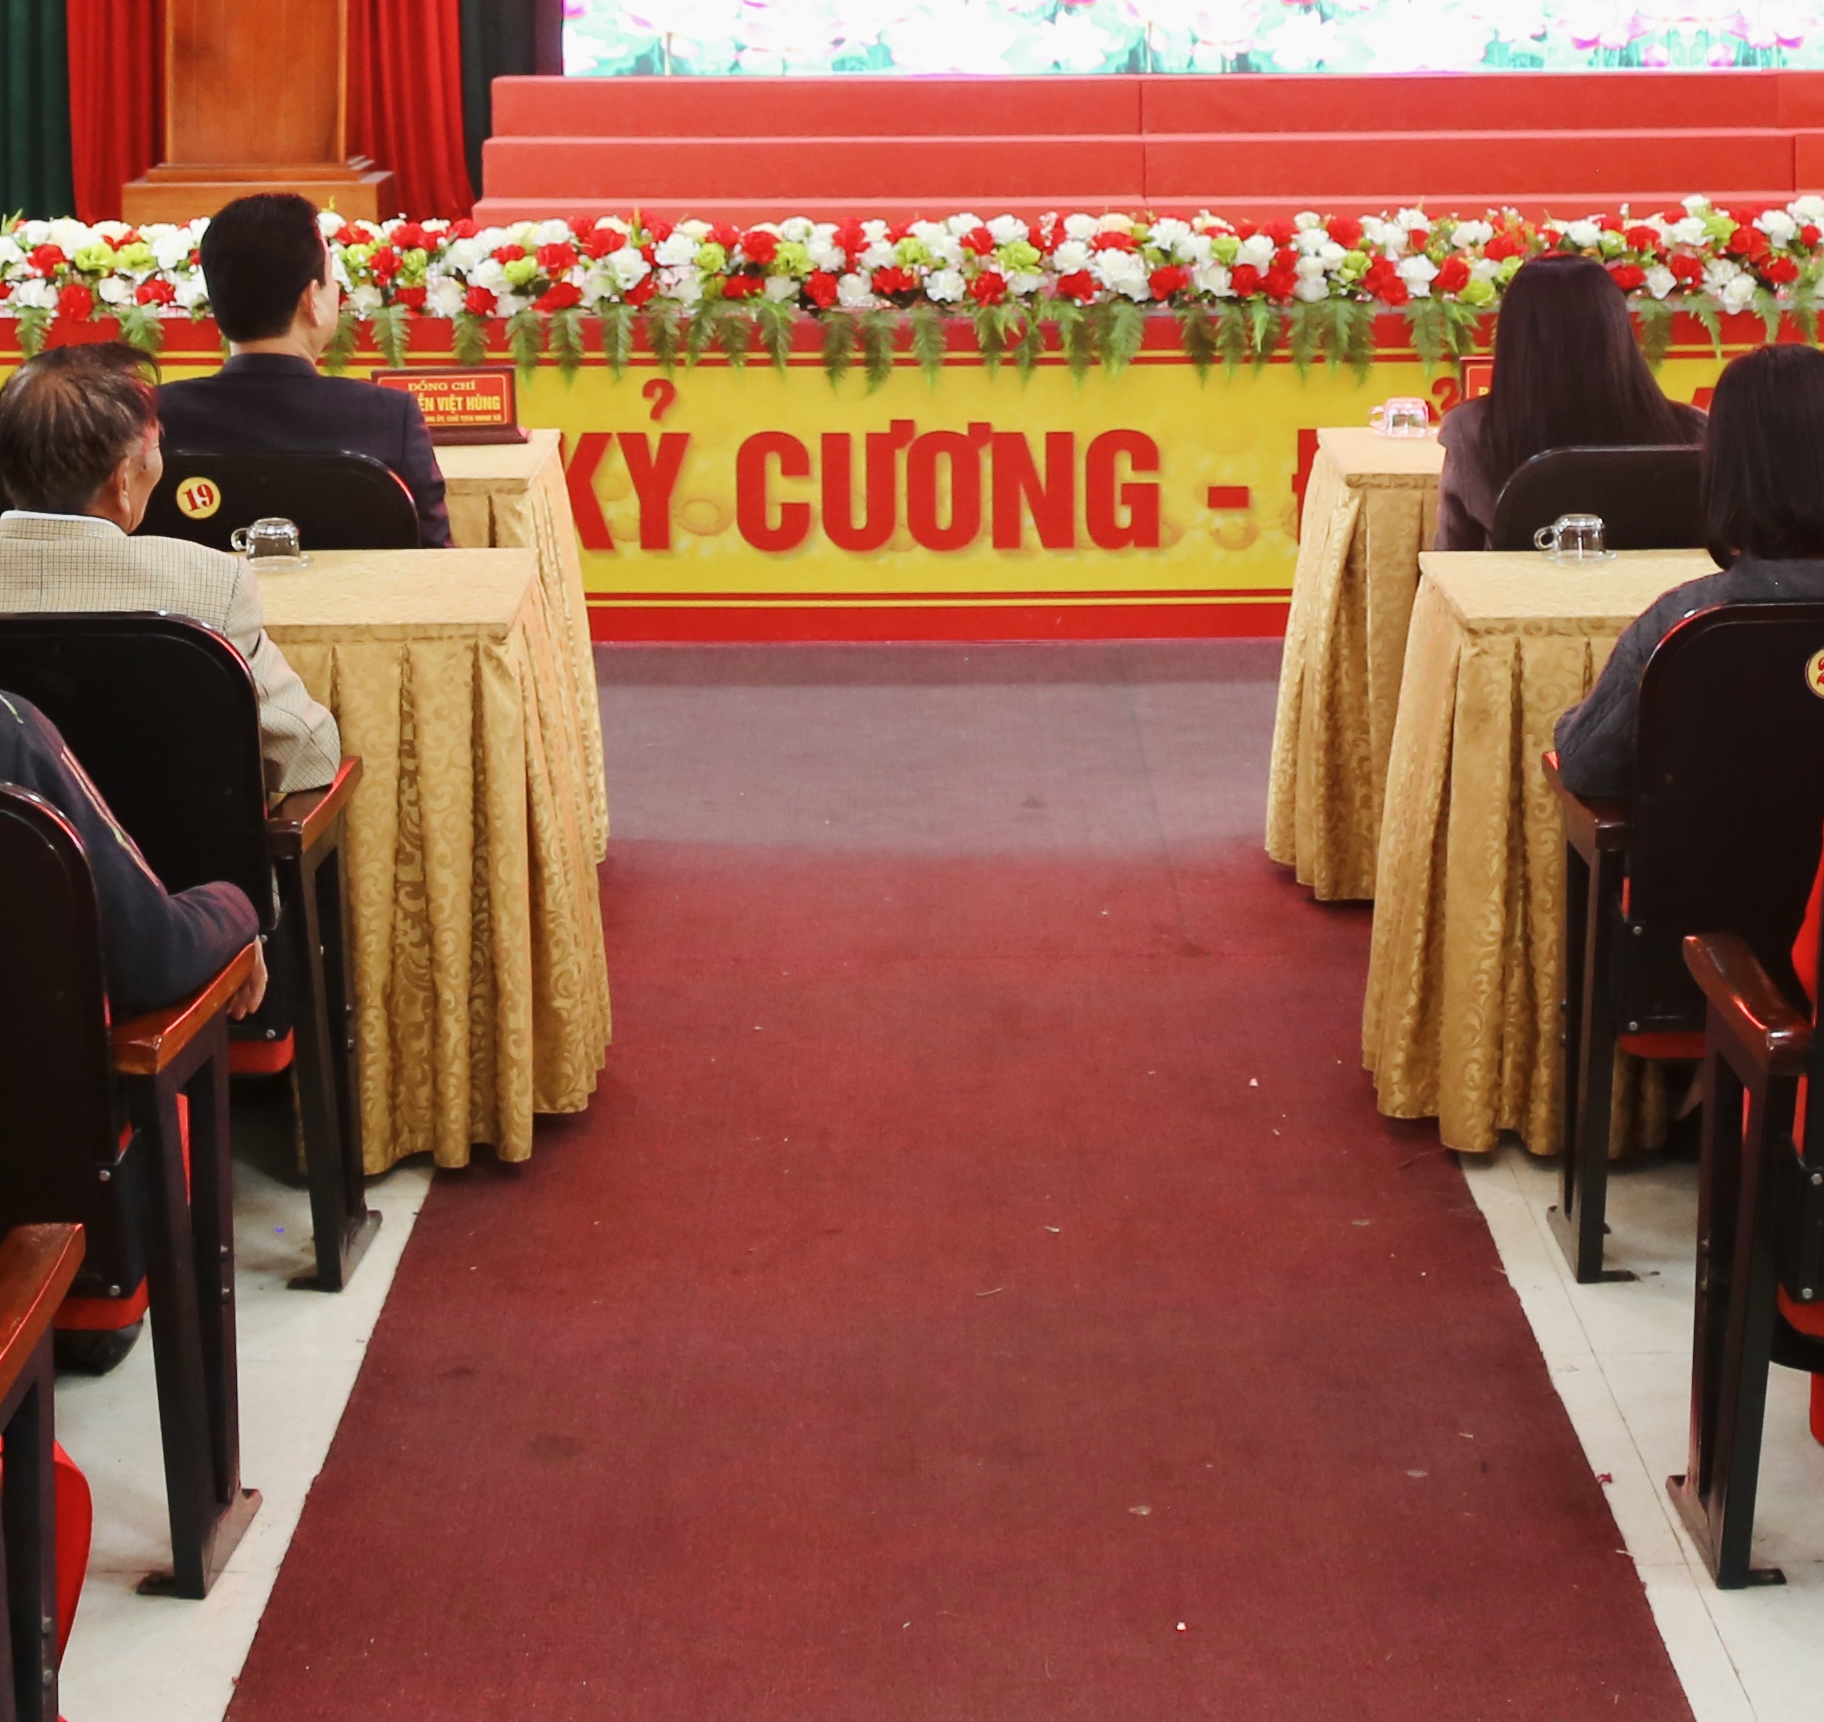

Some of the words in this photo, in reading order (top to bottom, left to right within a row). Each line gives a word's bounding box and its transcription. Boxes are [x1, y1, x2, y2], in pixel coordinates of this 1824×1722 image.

[182, 484, 215, 512] 19
[562, 379, 690, 551] KỶ
[737, 420, 1160, 553] CƯƠNG
